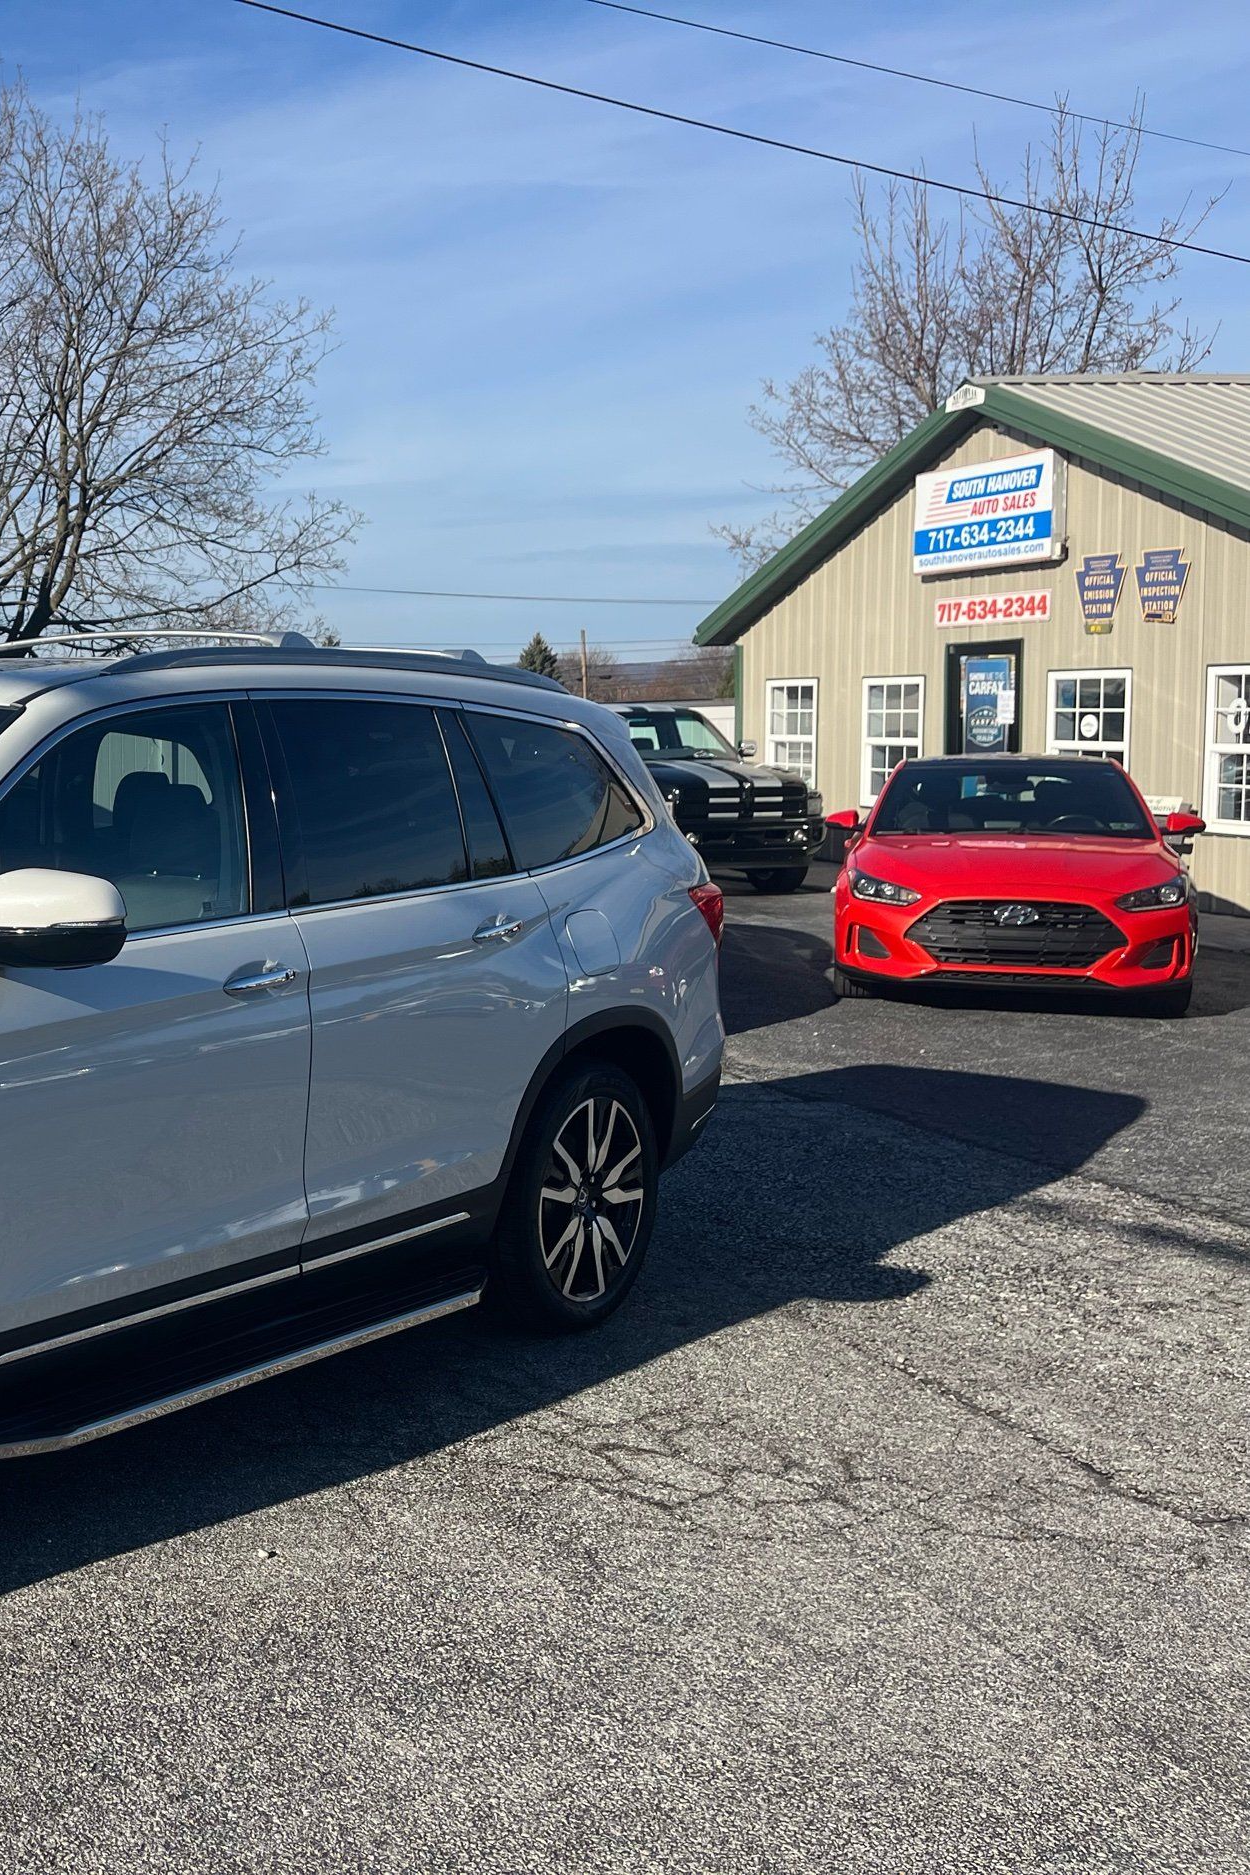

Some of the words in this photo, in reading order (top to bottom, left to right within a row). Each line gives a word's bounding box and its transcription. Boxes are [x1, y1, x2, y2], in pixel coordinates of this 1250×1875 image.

[952, 480, 984, 499] SOUTH
[987, 468, 1038, 493] HANOVER
[971, 498, 999, 516] AUTO
[1002, 491, 1037, 511] SALES
[928, 516, 1035, 552] 717-634-2344
[919, 542, 1044, 568] southhanoverautosales.com
[1084, 575, 1114, 586] OFFICIAL
[1144, 570, 1177, 582] OFFICIAL
[1084, 589, 1114, 601] EMISSION
[1141, 585, 1180, 597] INSPECTION
[937, 594, 1047, 622] 717-634-2344
[1085, 603, 1111, 614] STATION
[1144, 600, 1174, 611] STATION
[969, 681, 1005, 695] CARFAX
[971, 718, 1000, 727] CARFA
